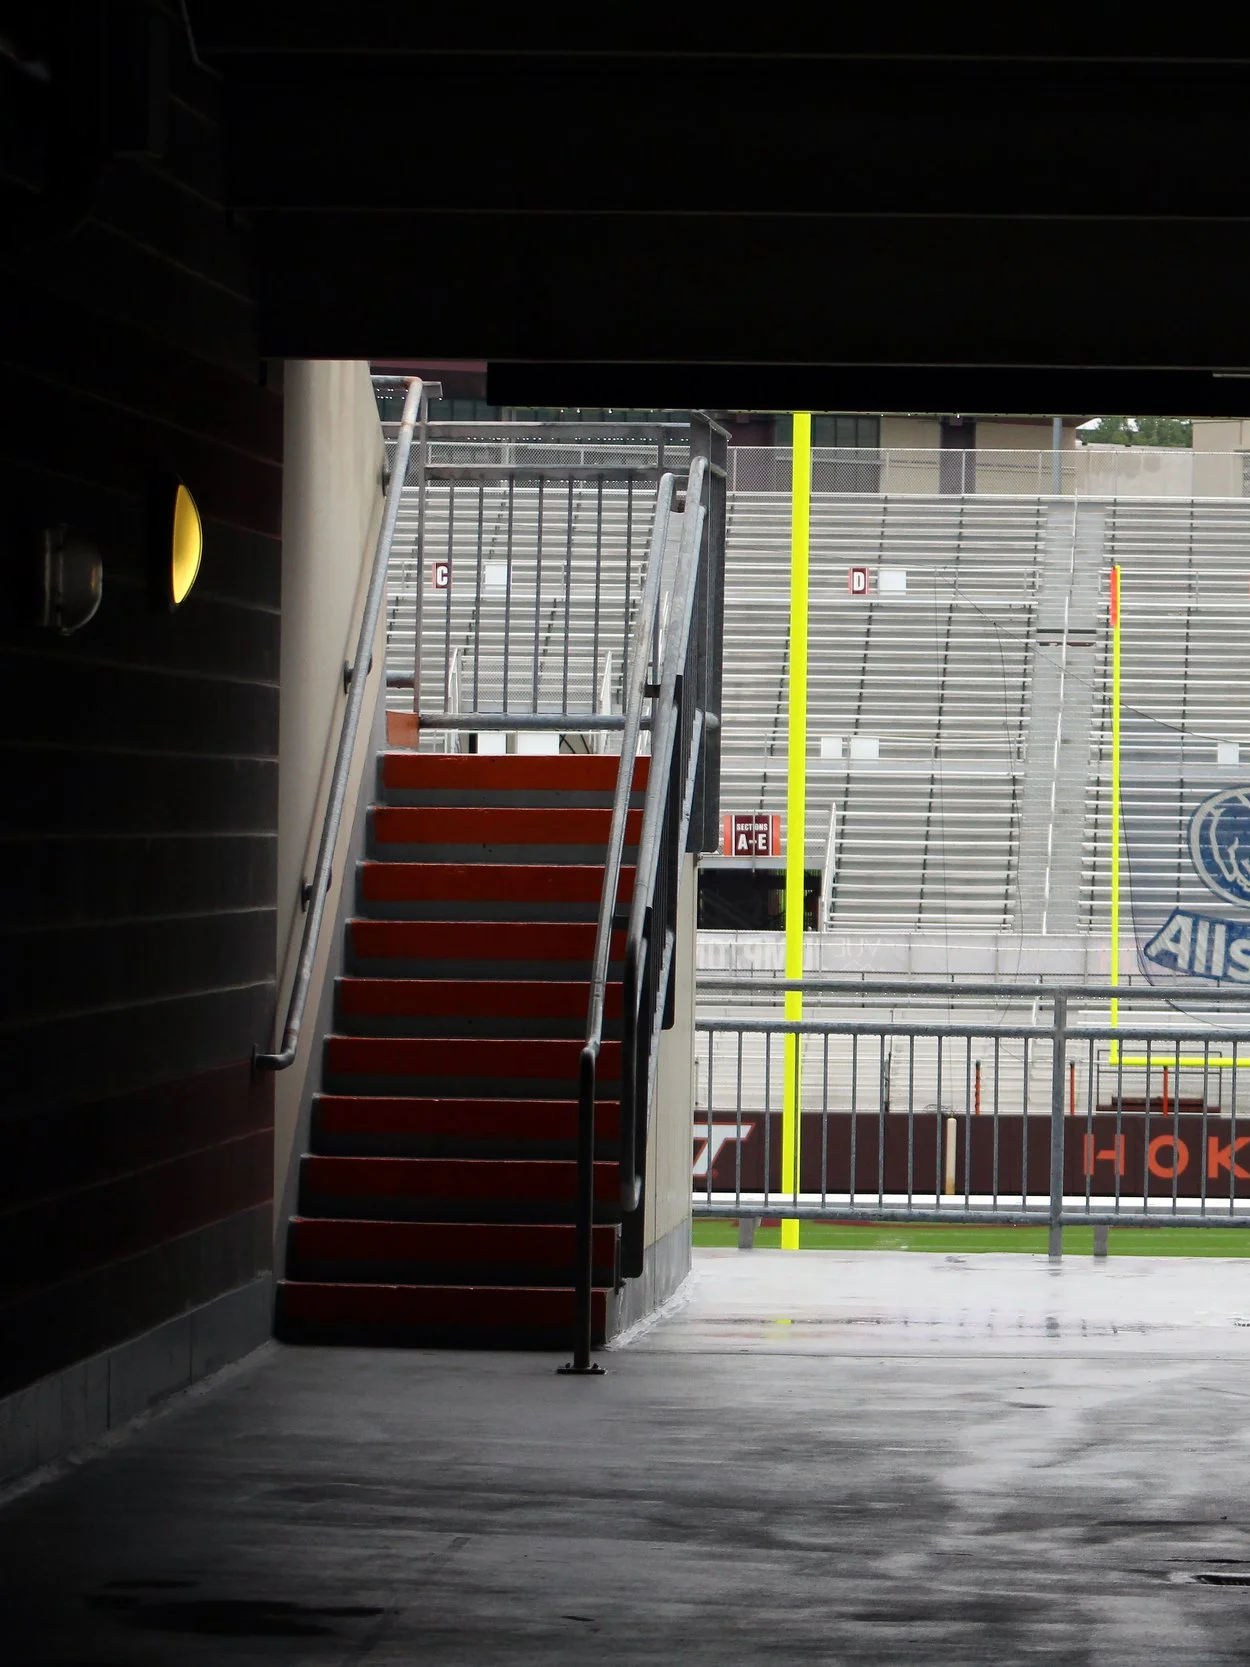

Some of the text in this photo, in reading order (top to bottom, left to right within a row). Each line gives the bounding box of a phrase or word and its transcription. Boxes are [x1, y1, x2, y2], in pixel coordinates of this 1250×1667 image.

[436, 565, 449, 586] C
[853, 571, 865, 591] D
[736, 823, 768, 831] SECTONS
[737, 833, 767, 850] A-E
